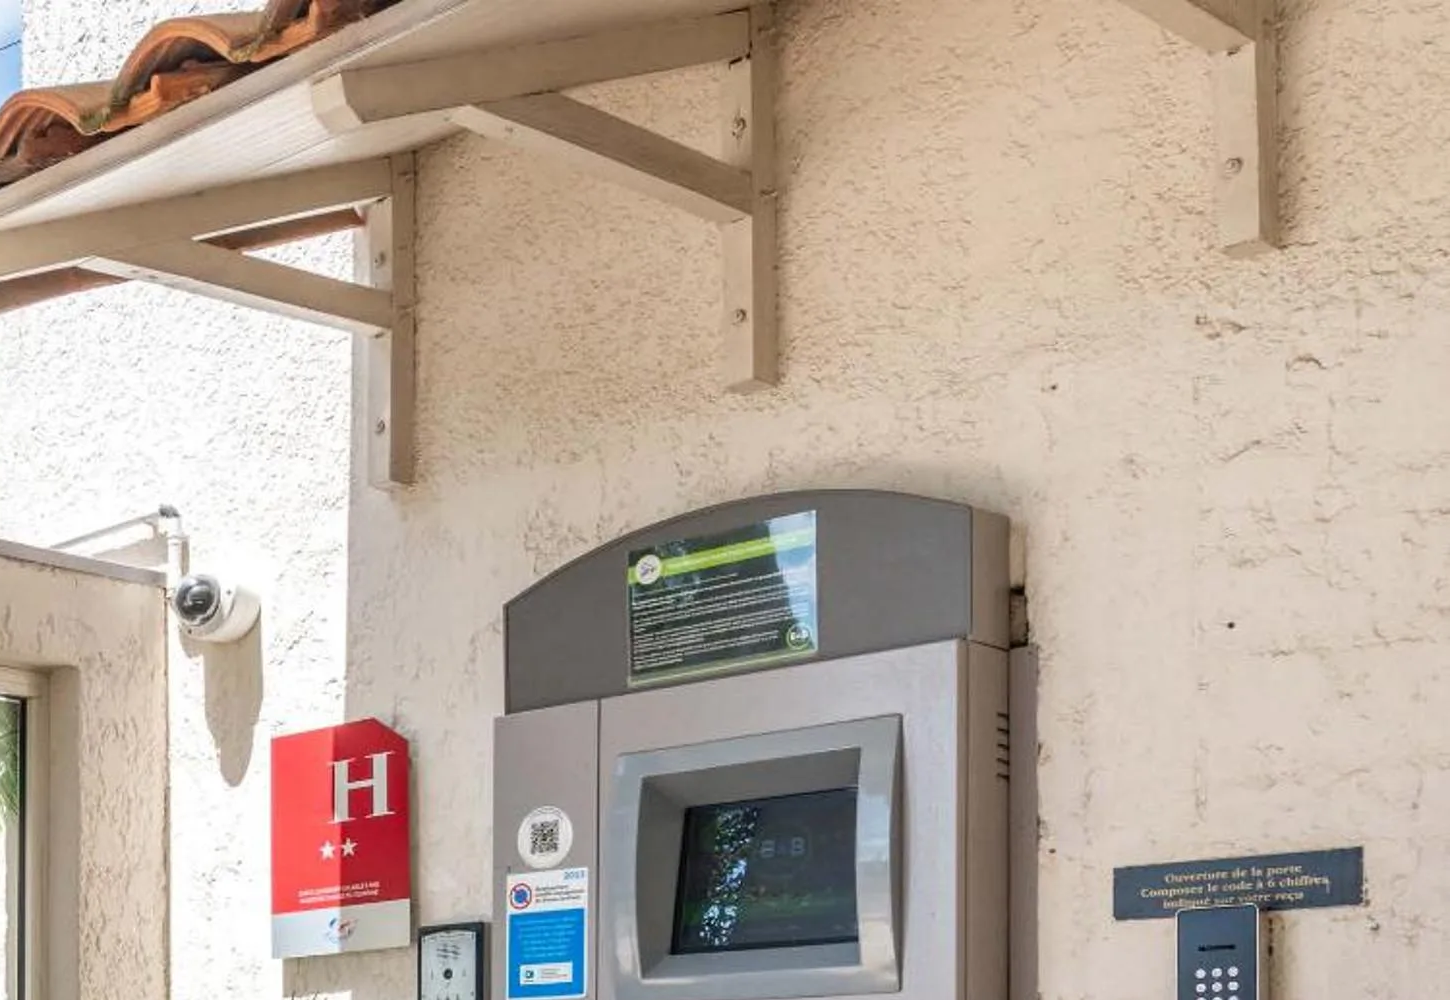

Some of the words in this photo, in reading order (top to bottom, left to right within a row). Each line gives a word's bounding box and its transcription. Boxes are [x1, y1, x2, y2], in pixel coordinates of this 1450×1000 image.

[327, 751, 396, 825] H
[1164, 869, 1230, 883] Ouverture
[1231, 868, 1247, 878] de
[1251, 866, 1263, 877] la
[1267, 865, 1303, 878] porte
[1140, 886, 1203, 898] Composer
[1207, 883, 1219, 892] le
[1222, 880, 1254, 892] code
[1267, 878, 1275, 888] 6
[1279, 875, 1330, 888] chiffres
[1238, 892, 1270, 902] votre
[1275, 891, 1304, 902] reçu
